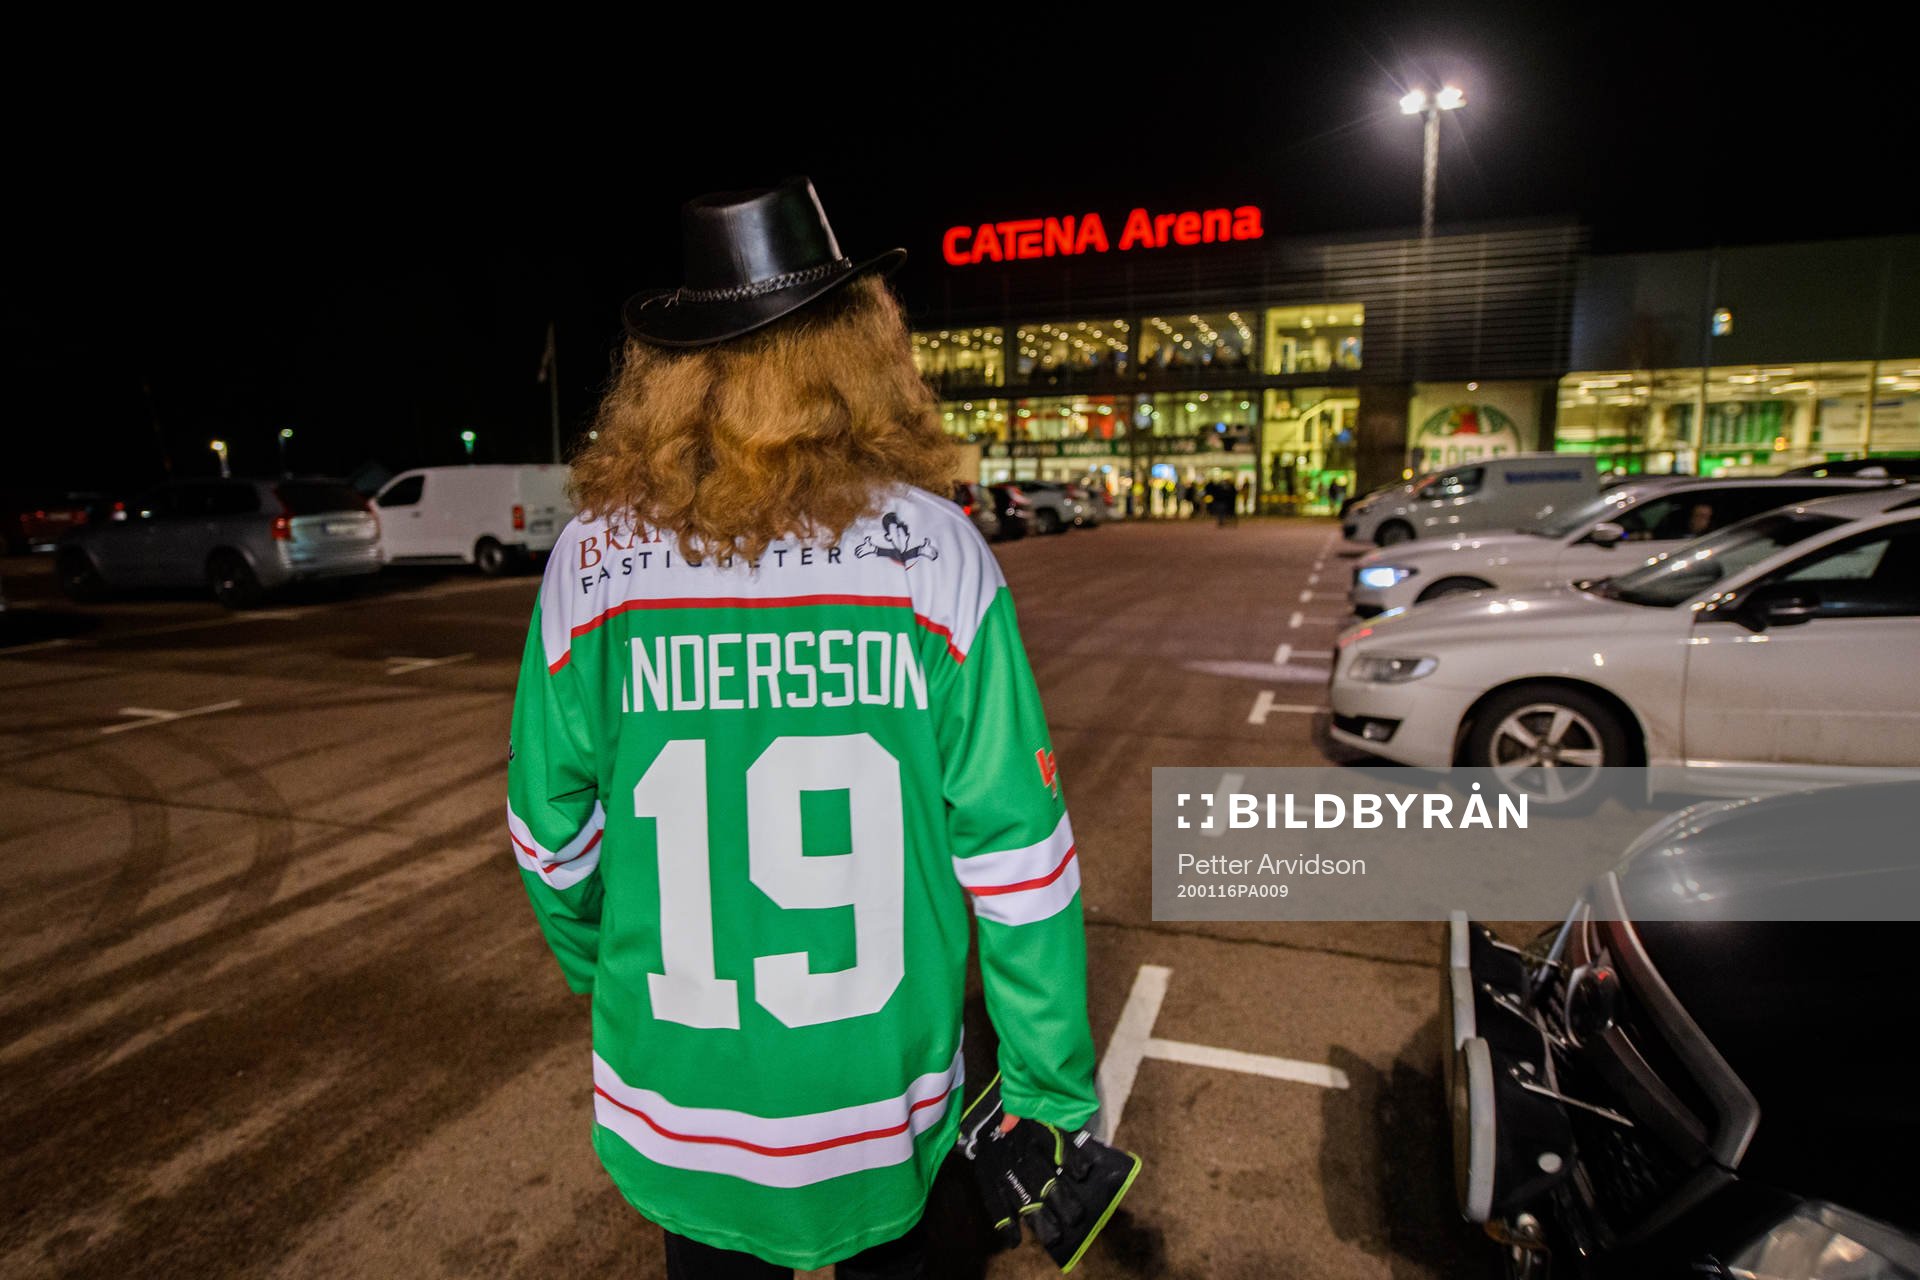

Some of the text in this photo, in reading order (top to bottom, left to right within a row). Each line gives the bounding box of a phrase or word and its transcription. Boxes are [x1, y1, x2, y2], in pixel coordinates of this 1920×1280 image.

[943, 205, 1264, 265] CATENA Arena
[581, 547, 842, 594] FASTITER
[633, 732, 905, 1031] 19
